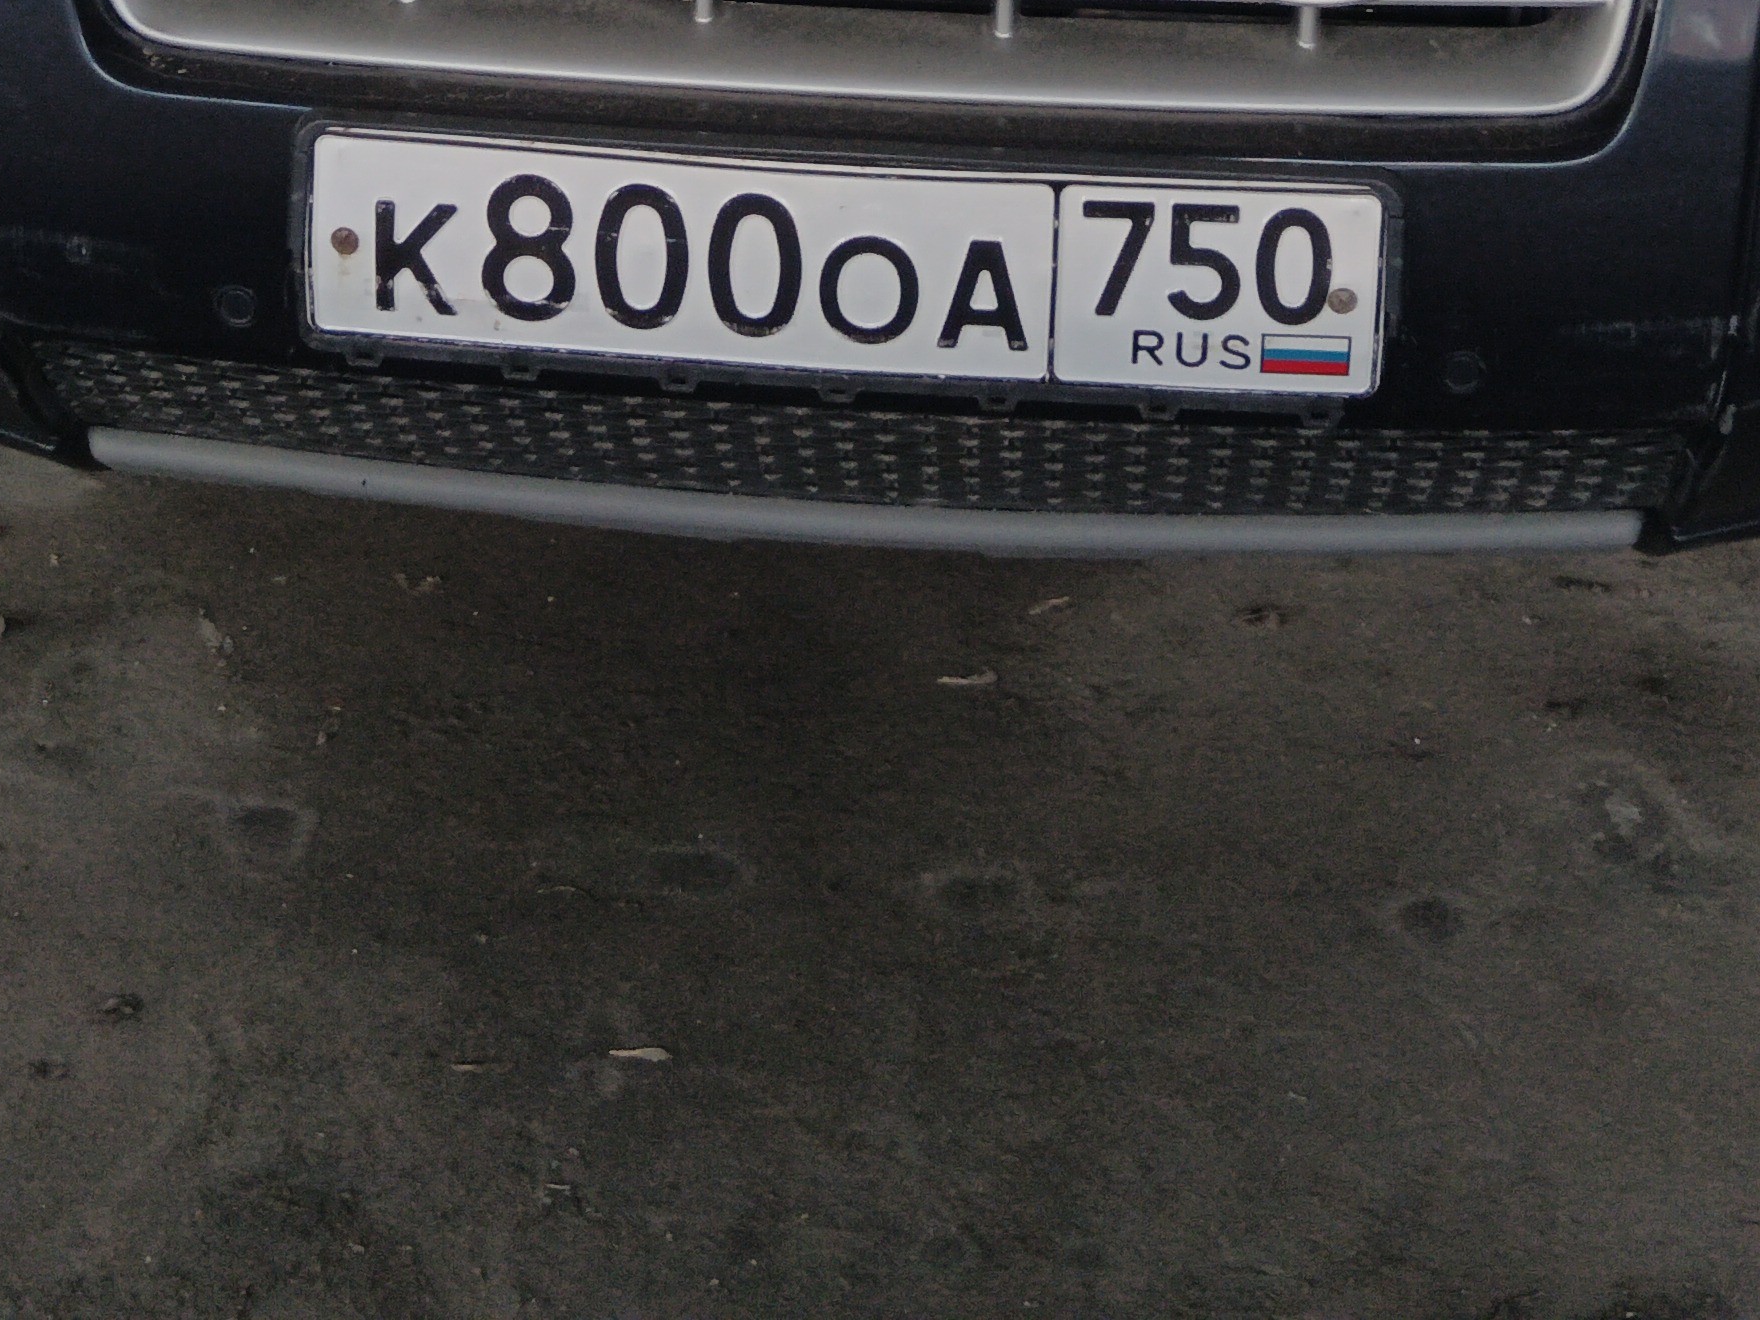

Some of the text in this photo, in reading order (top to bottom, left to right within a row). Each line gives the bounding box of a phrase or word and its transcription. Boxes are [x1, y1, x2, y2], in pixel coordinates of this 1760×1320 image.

[374, 172, 1332, 352] К800ОА 750
[1131, 329, 1253, 371] RUS
